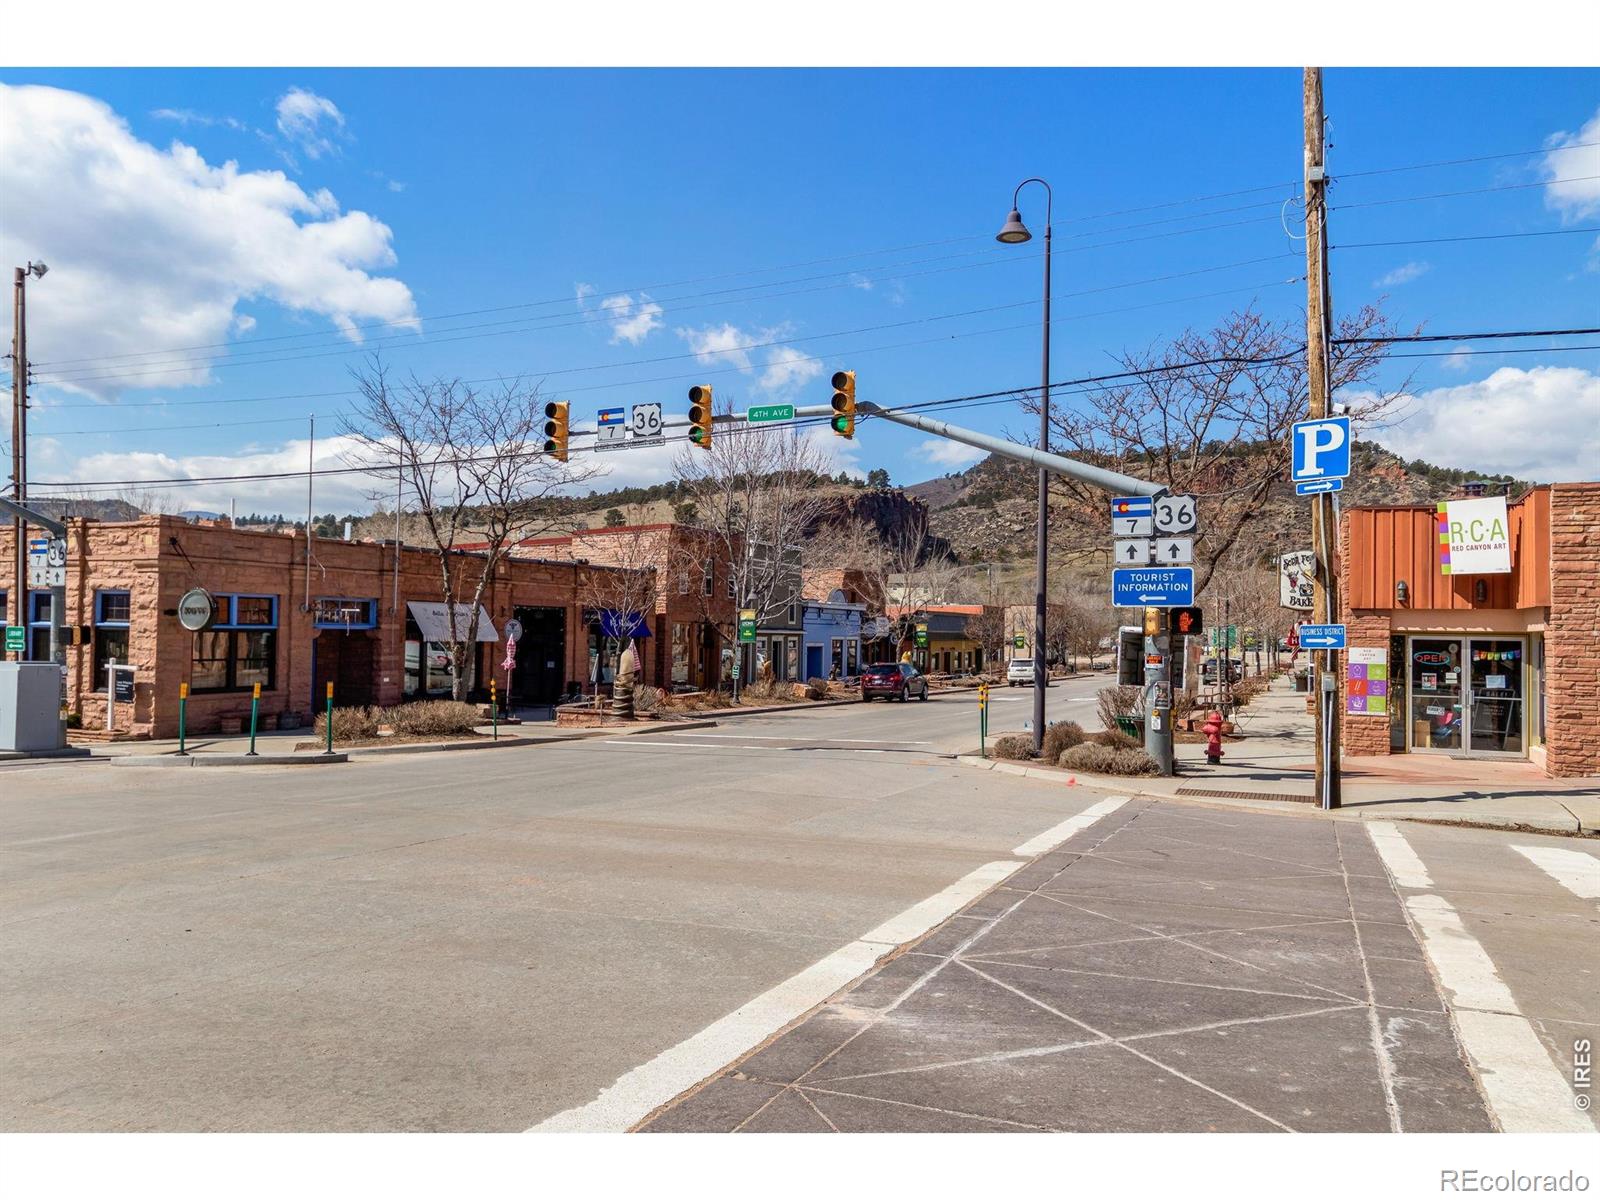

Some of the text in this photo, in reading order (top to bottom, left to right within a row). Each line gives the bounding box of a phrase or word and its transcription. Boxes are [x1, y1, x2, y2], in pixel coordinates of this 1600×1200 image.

[753, 408, 789, 418] 4TH AVE
[636, 411, 659, 430] 36
[607, 426, 616, 438] 7
[1296, 423, 1345, 477] P
[1159, 504, 1192, 526] 36
[1126, 519, 1138, 533] 7
[1466, 543, 1491, 551] CANYON
[1493, 542, 1507, 550] ART
[50, 545, 65, 561] 36
[35, 555, 41, 565] 7
[1130, 573, 1176, 582] TOURIST
[1118, 583, 1188, 592] INFORMATION
[1301, 627, 1344, 636] BUSINESS DISTRICT
